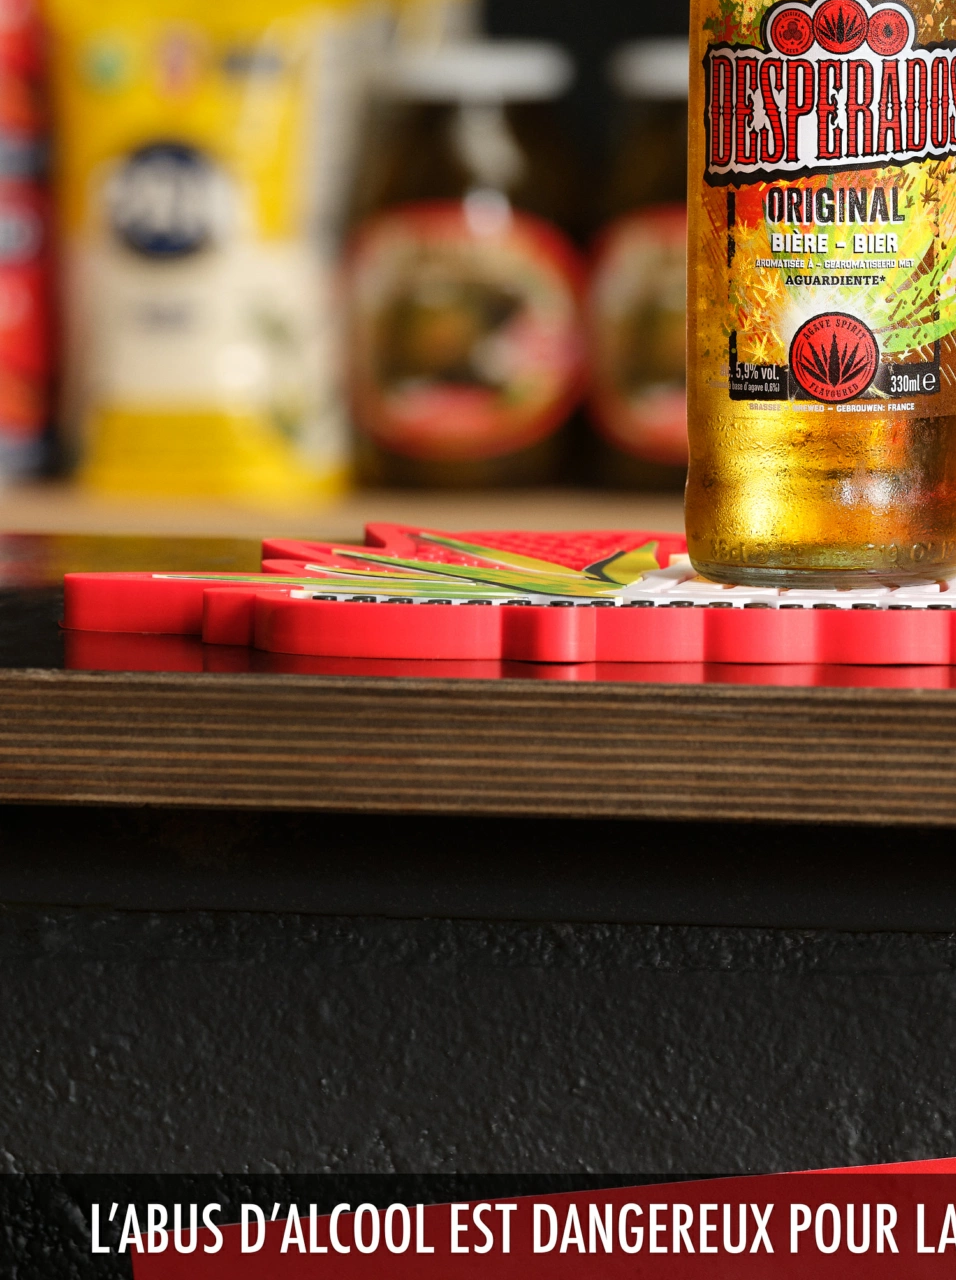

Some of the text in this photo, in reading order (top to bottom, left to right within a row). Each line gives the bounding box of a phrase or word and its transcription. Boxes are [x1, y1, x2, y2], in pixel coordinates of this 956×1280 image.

[766, 186, 906, 224] ORIGINAL
[771, 230, 828, 253] BIÈRE
[853, 233, 898, 253] BIER
[898, 258, 915, 269] MET
[803, 318, 867, 341] AGAVE SPIRIT
[736, 362, 759, 380] 5,9%
[761, 363, 780, 380] vol.
[809, 382, 859, 398] FLAVOURED
[890, 374, 921, 393] 330ml
[887, 403, 915, 411] FRANCE
